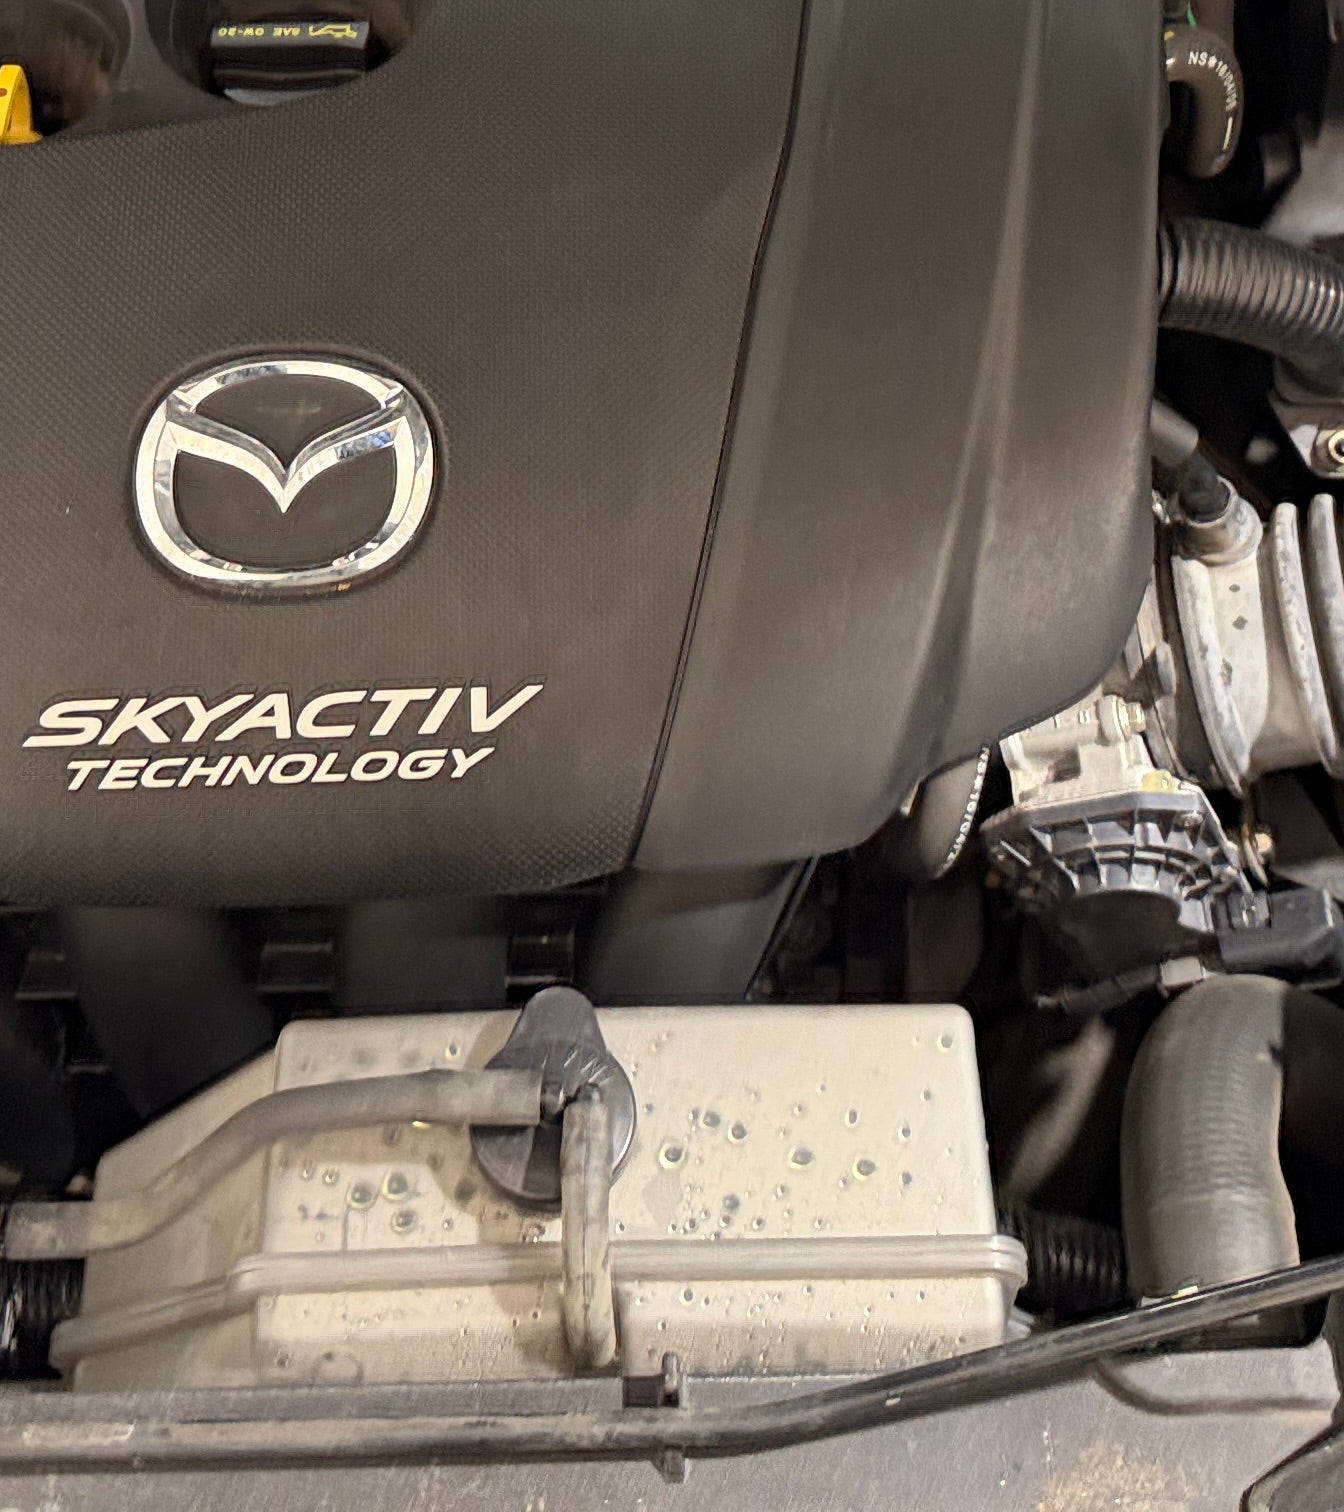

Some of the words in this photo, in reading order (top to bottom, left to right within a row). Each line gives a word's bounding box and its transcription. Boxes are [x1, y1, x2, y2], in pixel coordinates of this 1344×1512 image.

[273, 27, 300, 37] SAE
[21, 684, 544, 748] SKYACTIV
[66, 746, 496, 791] TECHNOLOGY
